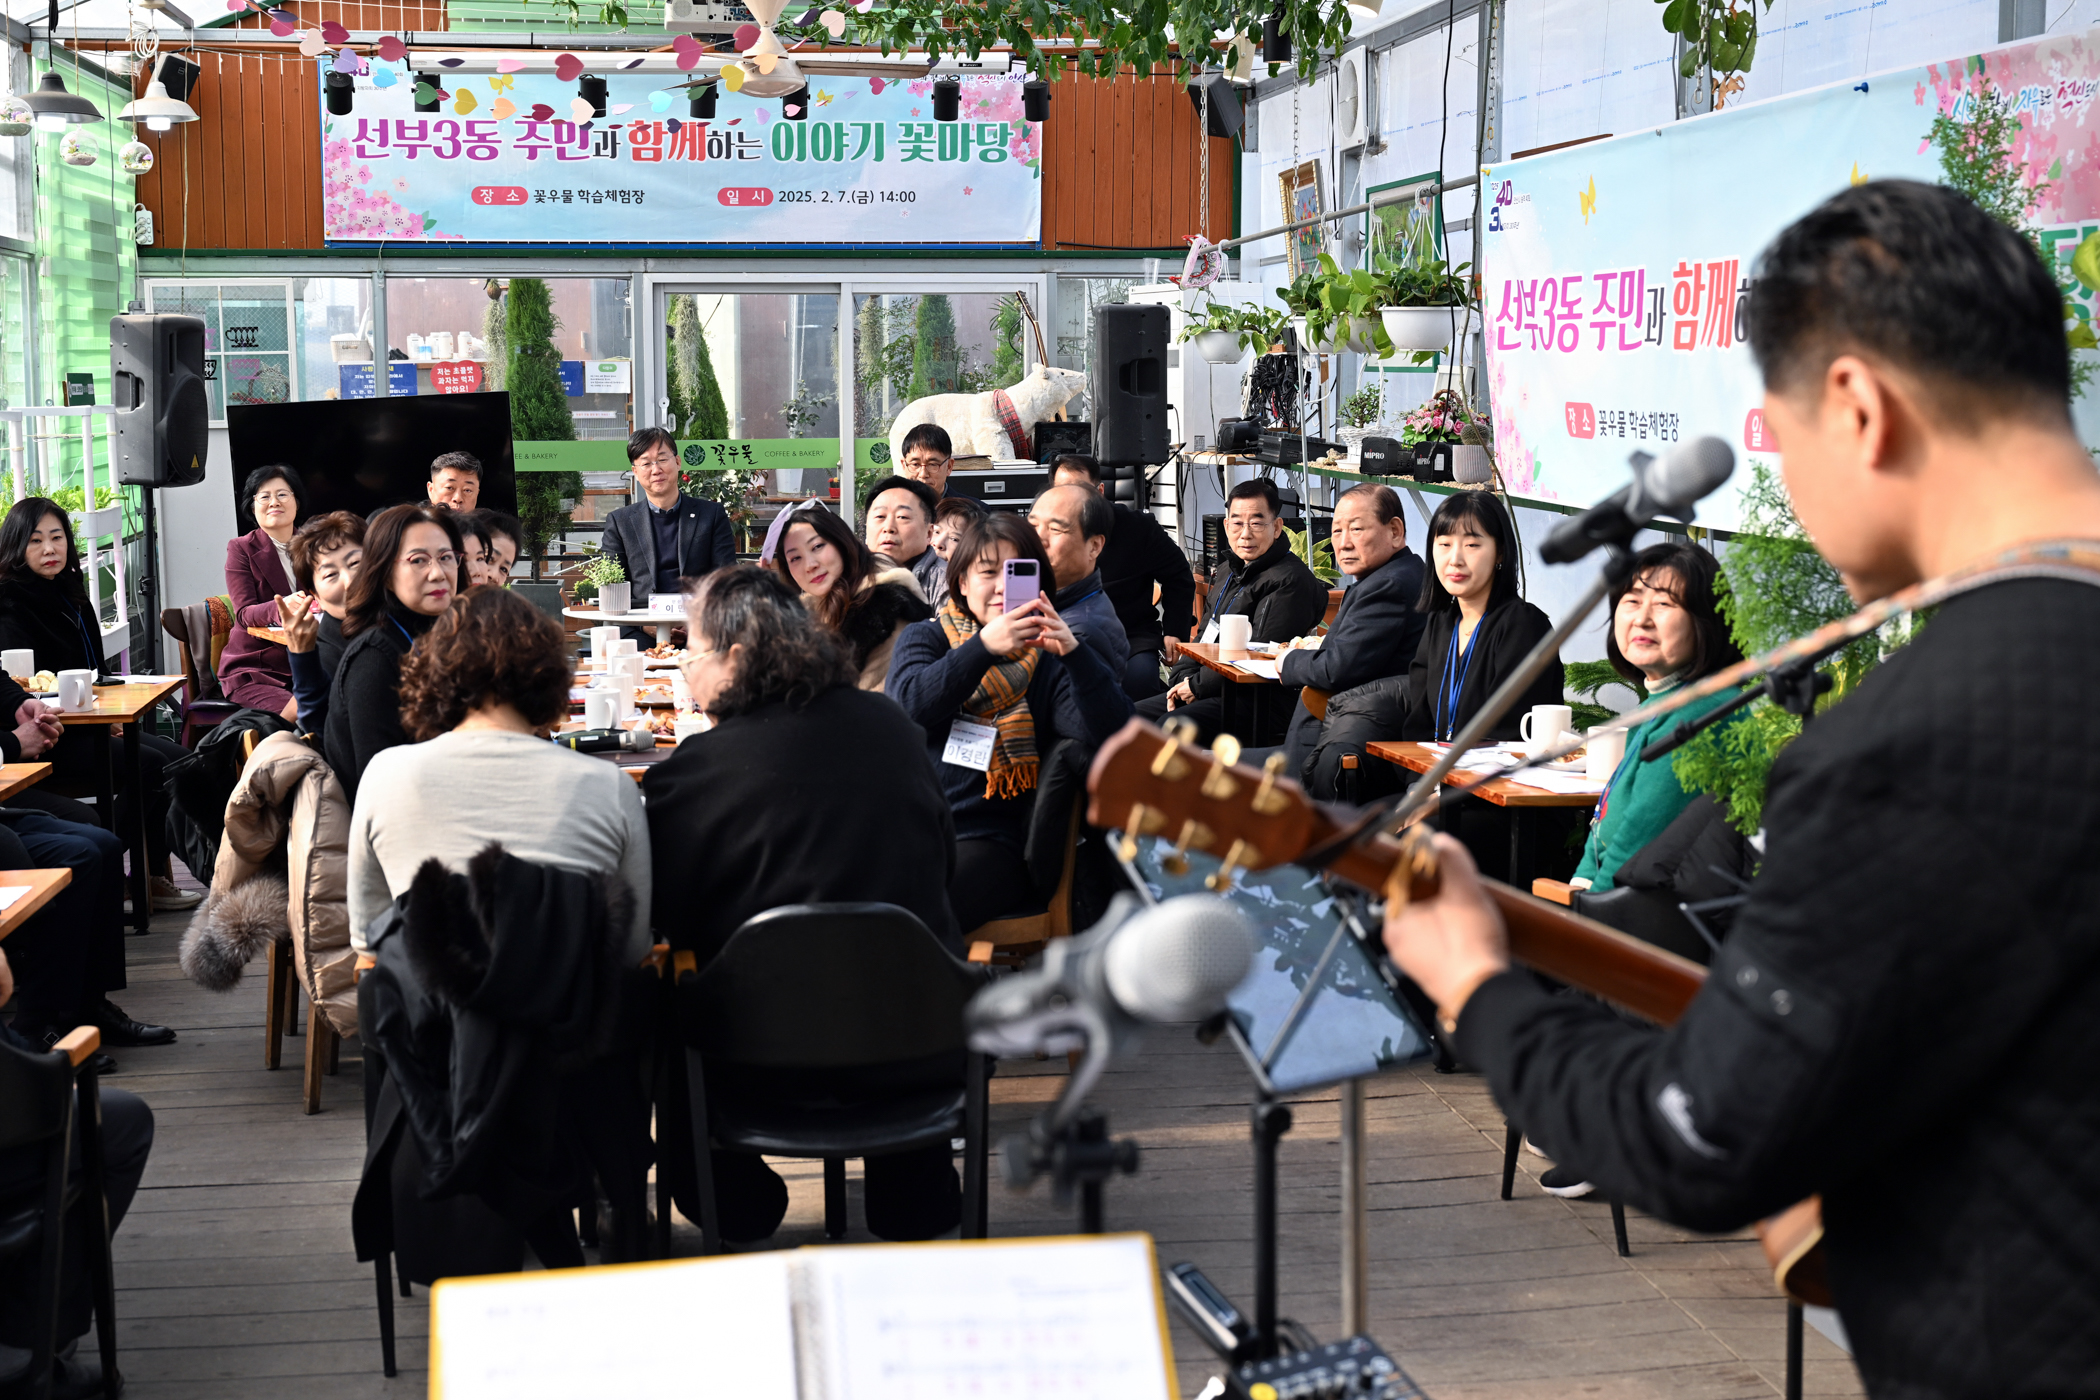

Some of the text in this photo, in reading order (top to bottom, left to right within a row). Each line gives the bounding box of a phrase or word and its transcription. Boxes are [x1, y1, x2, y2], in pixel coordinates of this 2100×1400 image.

[352, 118, 1014, 162] 선부3동 주민과 함께하는 이야기 꽃마당
[480, 189, 645, 204] 장 소 꽃우물 학습체험장
[726, 190, 916, 204] 일 시 2025. 2. 7.(금) 14:00
[1496, 259, 1751, 353] 선부3동 주민과 함께하
[1567, 407, 1577, 435] 장
[1582, 409, 1591, 432] 소
[1598, 410, 1626, 438] 꽃우물
[1628, 410, 1680, 443] 학습체험장
[710, 444, 758, 466] 꽃우물
[947, 745, 987, 766] 이경란
